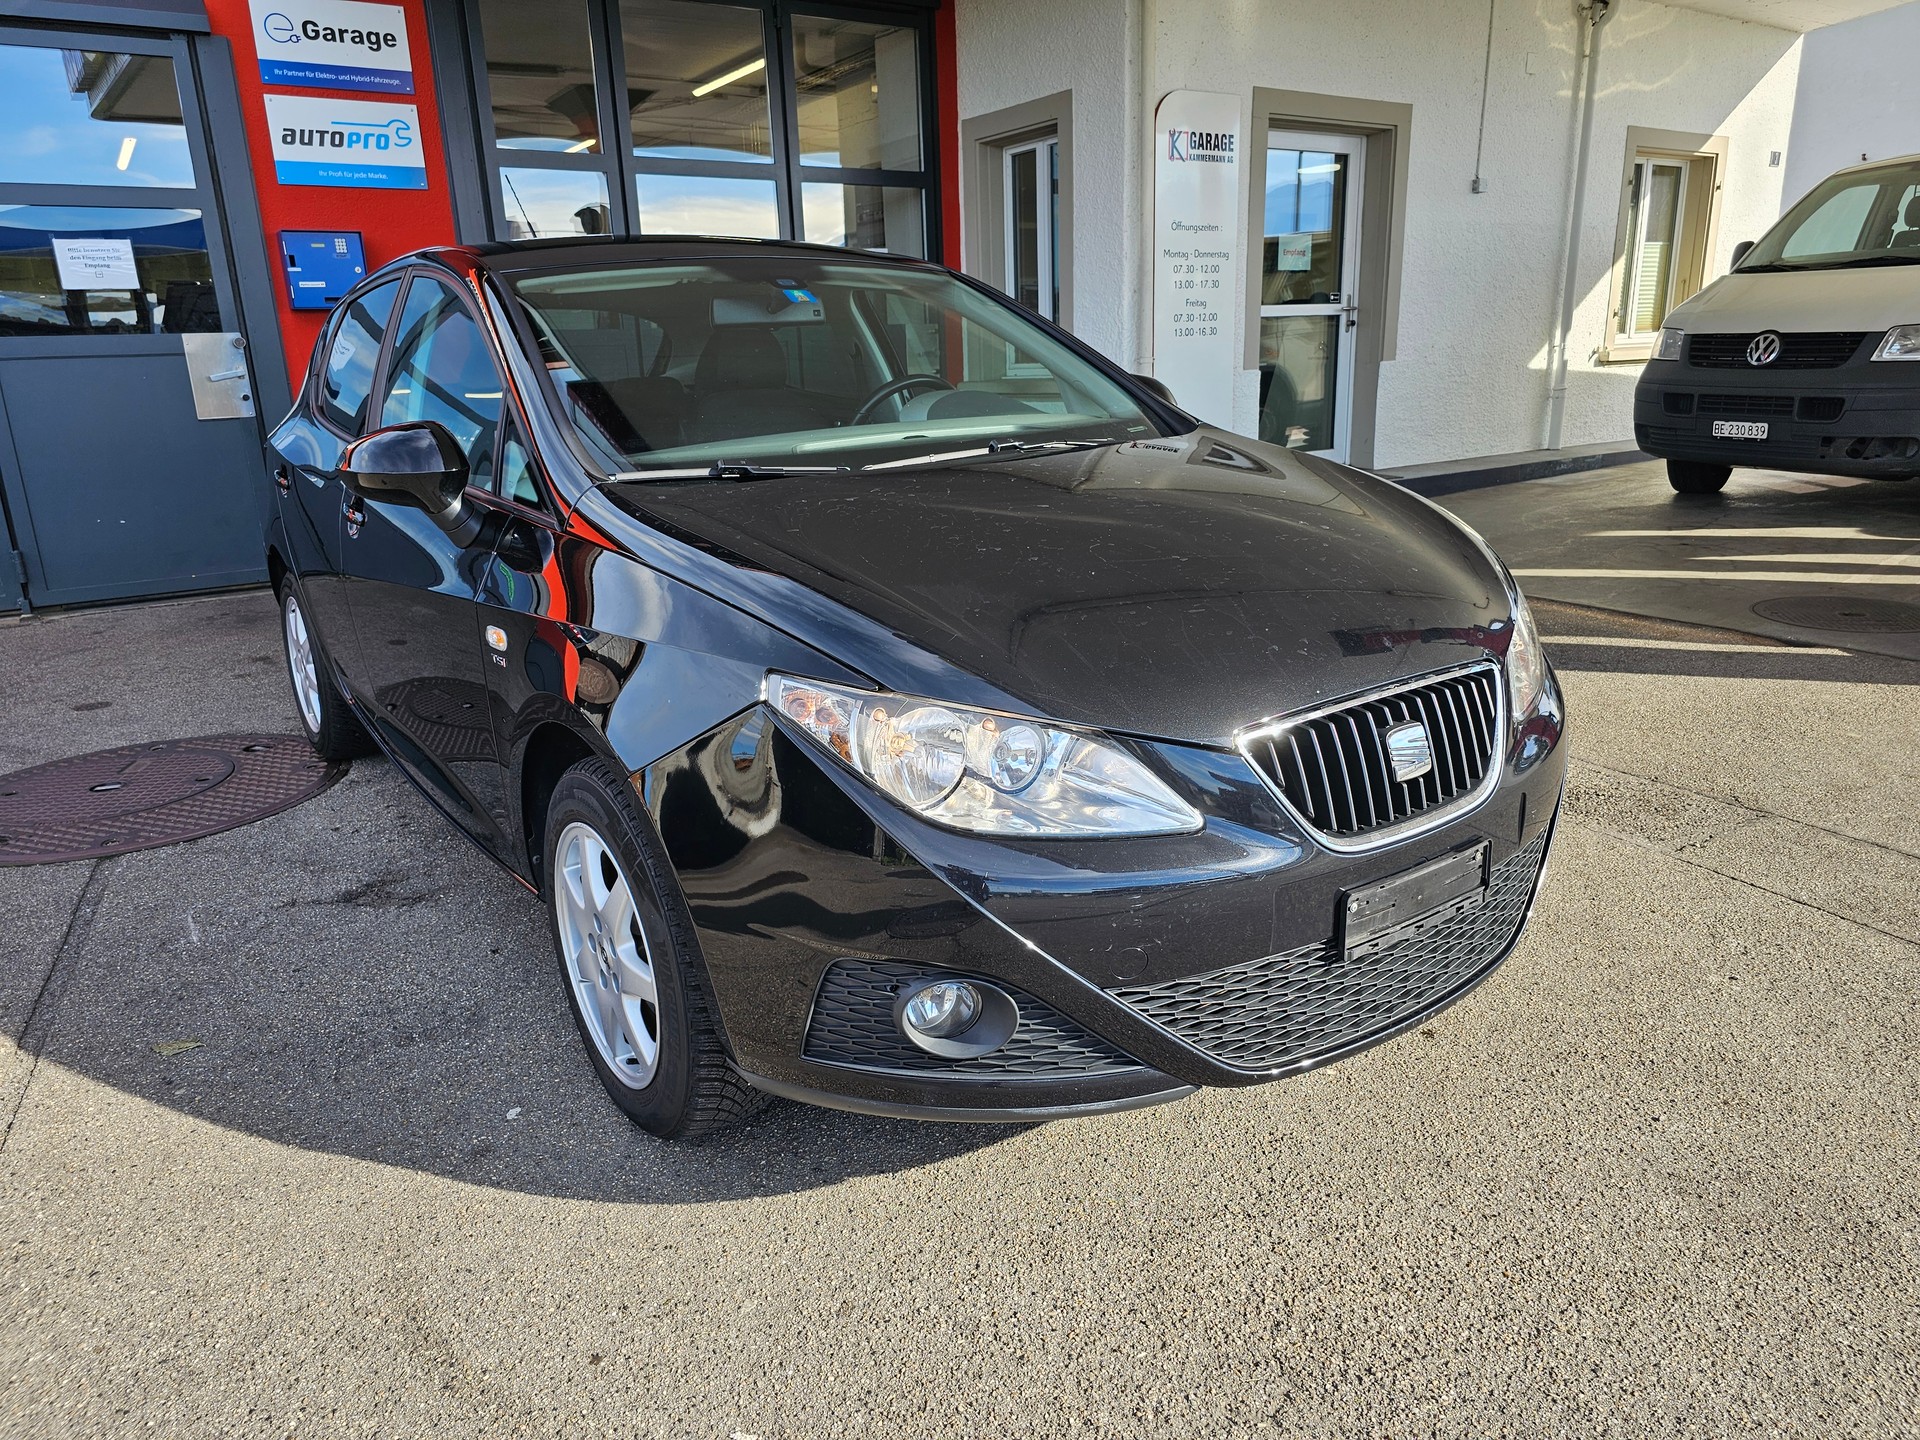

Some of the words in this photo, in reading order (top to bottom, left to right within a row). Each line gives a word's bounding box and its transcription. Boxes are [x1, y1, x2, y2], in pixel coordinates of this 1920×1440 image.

[283, 69, 305, 78] Partner
[315, 72, 338, 80] Elektro-
[1190, 131, 1234, 152] GARAGE
[1189, 154, 1226, 163] KAMMERMANN
[353, 171, 367, 179] jede
[1170, 220, 1219, 234] Öffnungszeiten
[1163, 249, 1189, 260] Montag
[1194, 249, 1230, 260] Donnerstag
[1283, 248, 1307, 257] Empfang
[1173, 264, 1194, 274] 07.30
[1201, 264, 1220, 274] 12.00
[1174, 280, 1194, 289] 13.00
[1200, 280, 1220, 289] 17.30
[1185, 298, 1207, 309] Freitag
[490, 653, 506, 668] TSI
